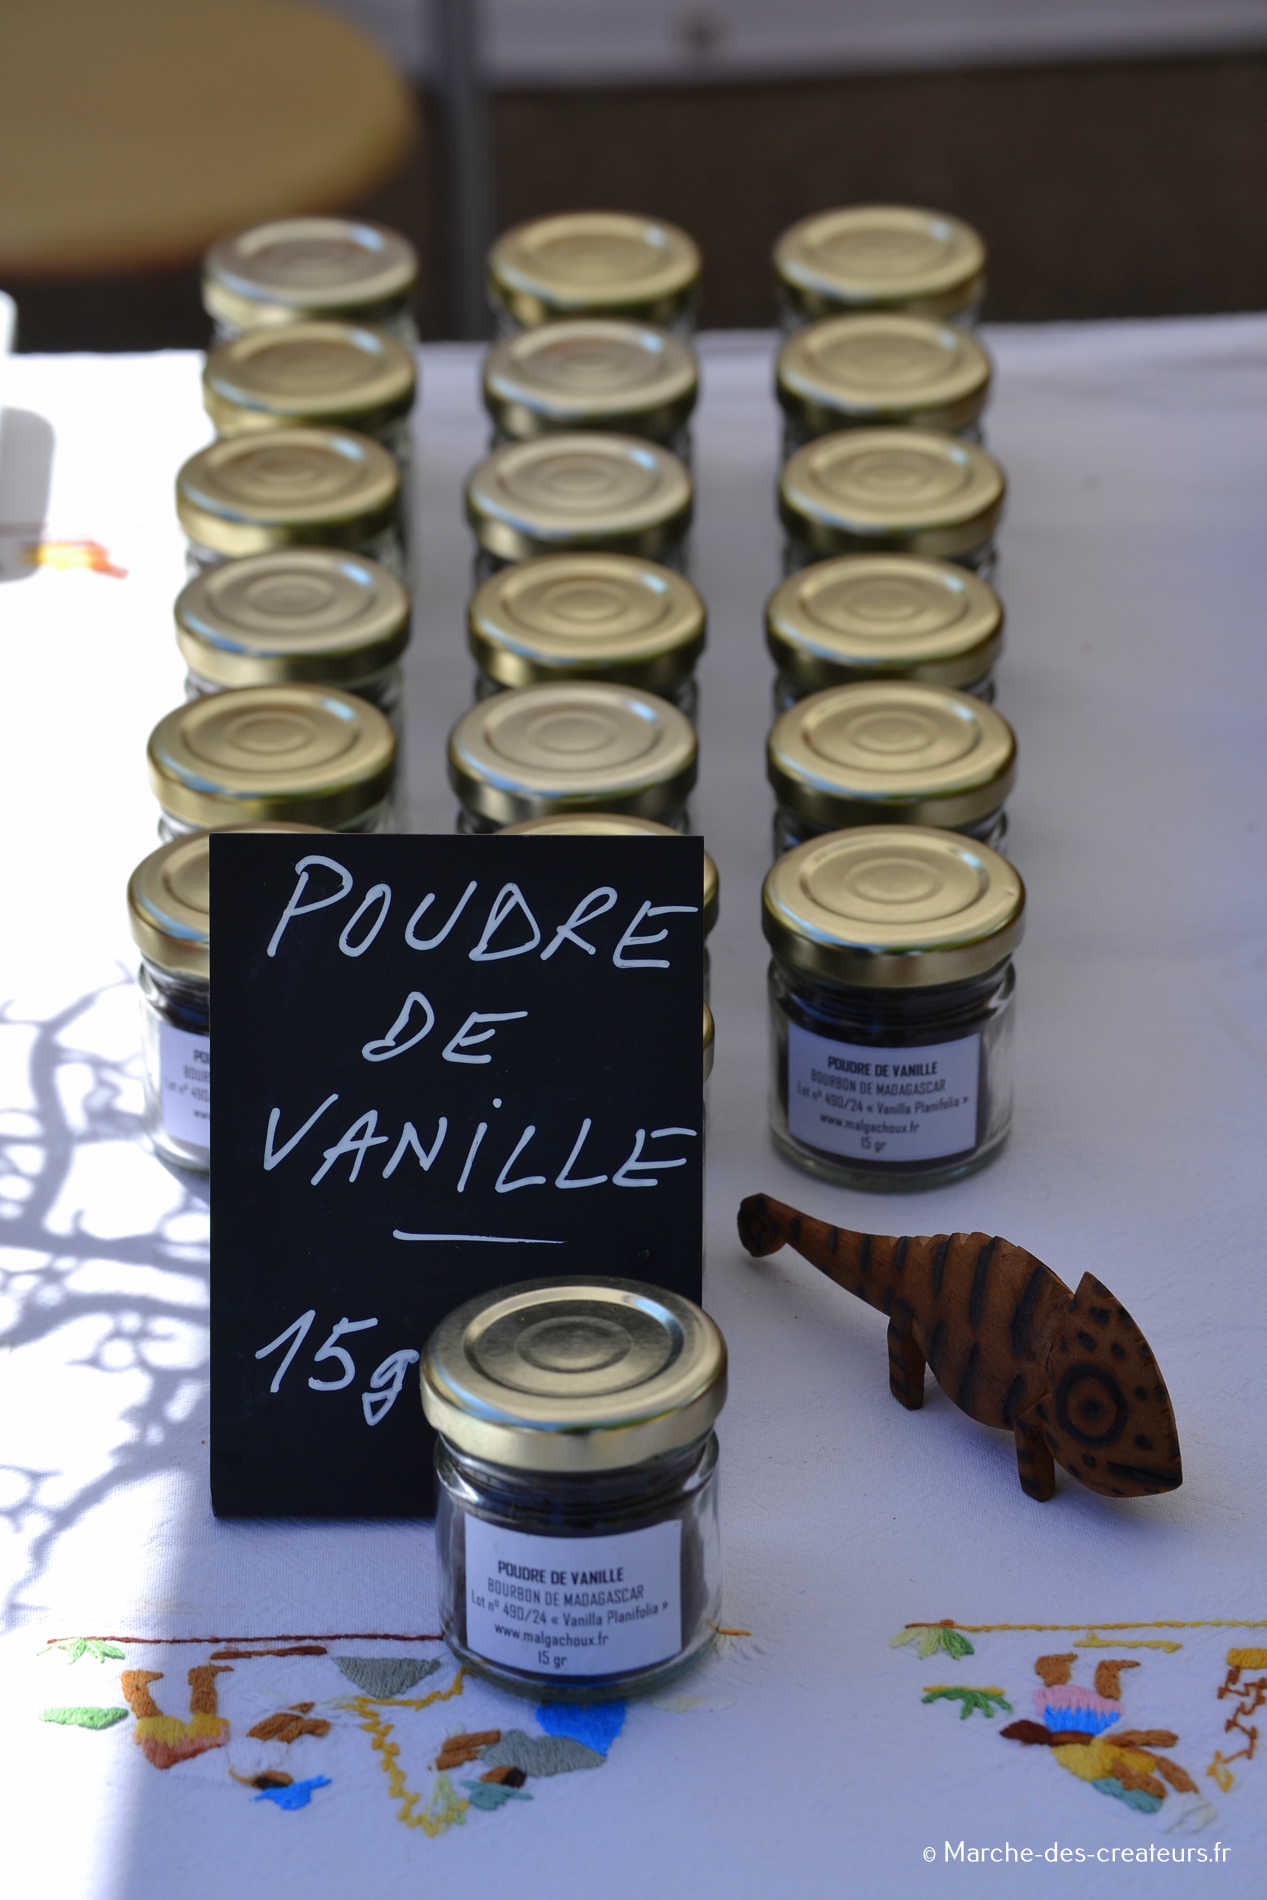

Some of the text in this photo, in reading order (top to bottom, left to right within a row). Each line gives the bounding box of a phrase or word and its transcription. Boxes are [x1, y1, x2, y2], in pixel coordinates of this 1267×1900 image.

[267, 854, 698, 968] POUDRE
[362, 991, 528, 1063] DE
[828, 1056, 938, 1077] POUDRE DE VANILLE
[810, 1069, 945, 1096] BOURBON DE MADAGASCAR
[877, 1102, 911, 1114] Vanilla
[820, 1114, 920, 1134] www.malgachoux.fr
[263, 1093, 697, 1194] VANILLE
[861, 1136, 886, 1152] 15 gr
[255, 1309, 420, 1426] 15g
[498, 1560, 624, 1586] POUDRE DE VANILLE
[488, 1577, 644, 1607] BOURBON DE MADAGASCAR
[471, 1589, 485, 1608] Lot
[503, 1605, 546, 1624] 490/24
[563, 1613, 602, 1627] Vanilla
[607, 1603, 658, 1624] Planifolia
[495, 1622, 608, 1648] www.malgachoux.fr
[538, 1650, 567, 1669] 15 gr
